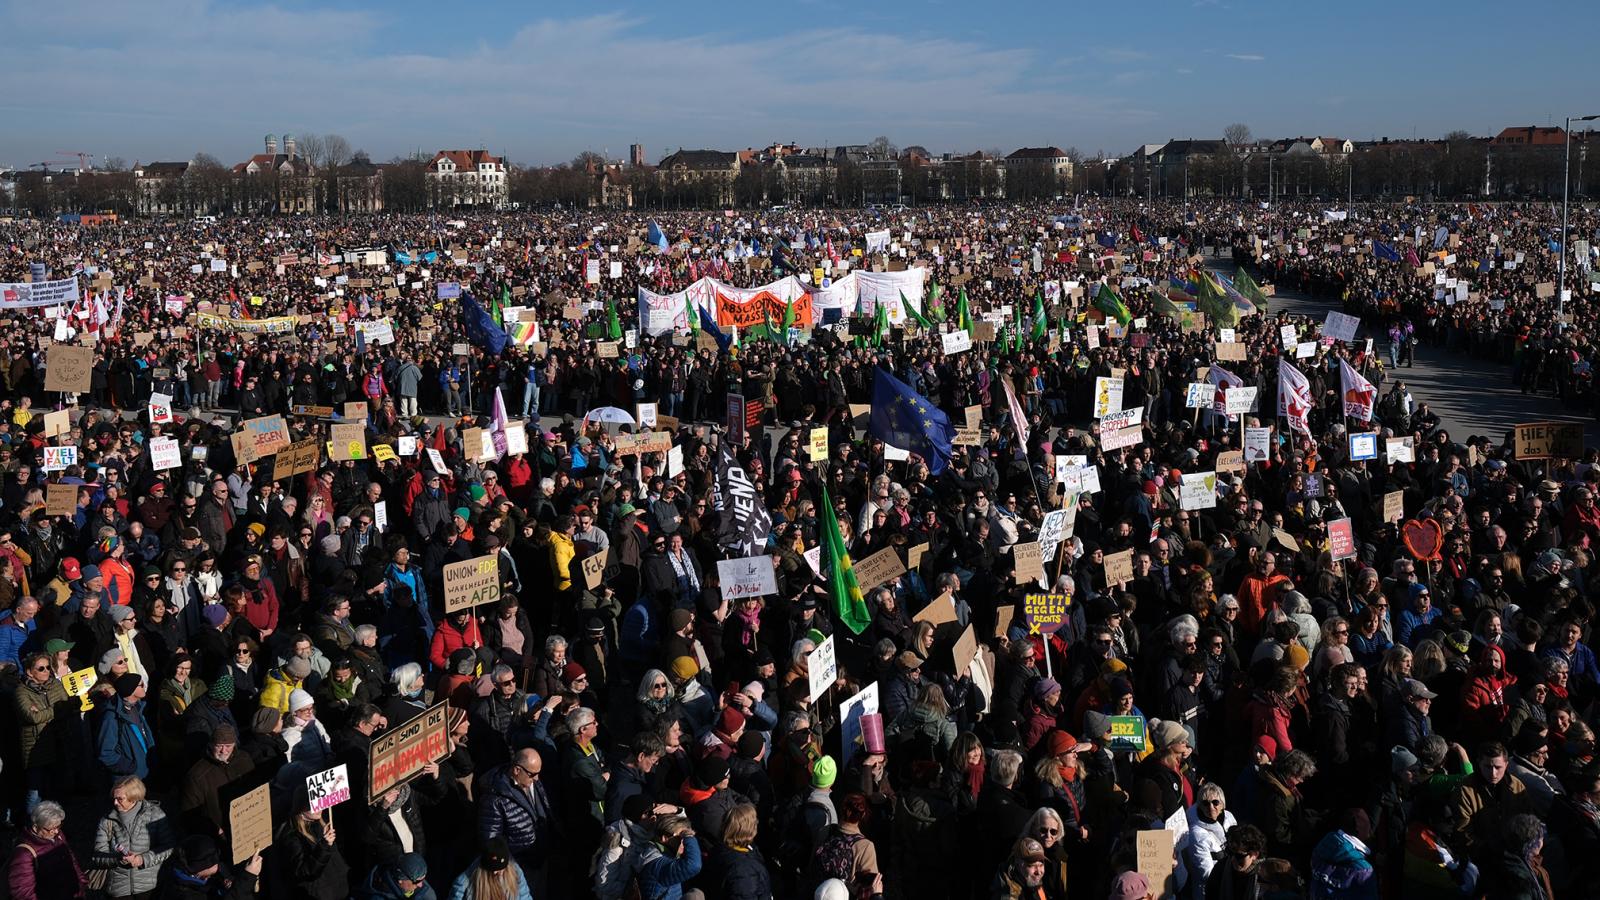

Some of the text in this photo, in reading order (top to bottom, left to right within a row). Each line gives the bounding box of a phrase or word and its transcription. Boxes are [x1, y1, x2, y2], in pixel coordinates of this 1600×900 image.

[1101, 420, 1129, 433] STOPPEN
[1521, 426, 1554, 440] HIER
[47, 448, 74, 457] VIEL
[1524, 442, 1541, 454] das
[47, 457, 74, 465] FALT
[478, 559, 497, 575] FDP
[584, 556, 604, 576] fck
[448, 576, 495, 594] WAHLHELFER
[450, 585, 498, 606] DER AFD
[1025, 606, 1064, 614] GEGEN
[1033, 615, 1060, 624] RECHTS
[376, 710, 442, 754] WIR SIND DIE
[1111, 723, 1134, 735] ERZ
[308, 769, 335, 789] ALICE
[309, 787, 327, 800] INS
